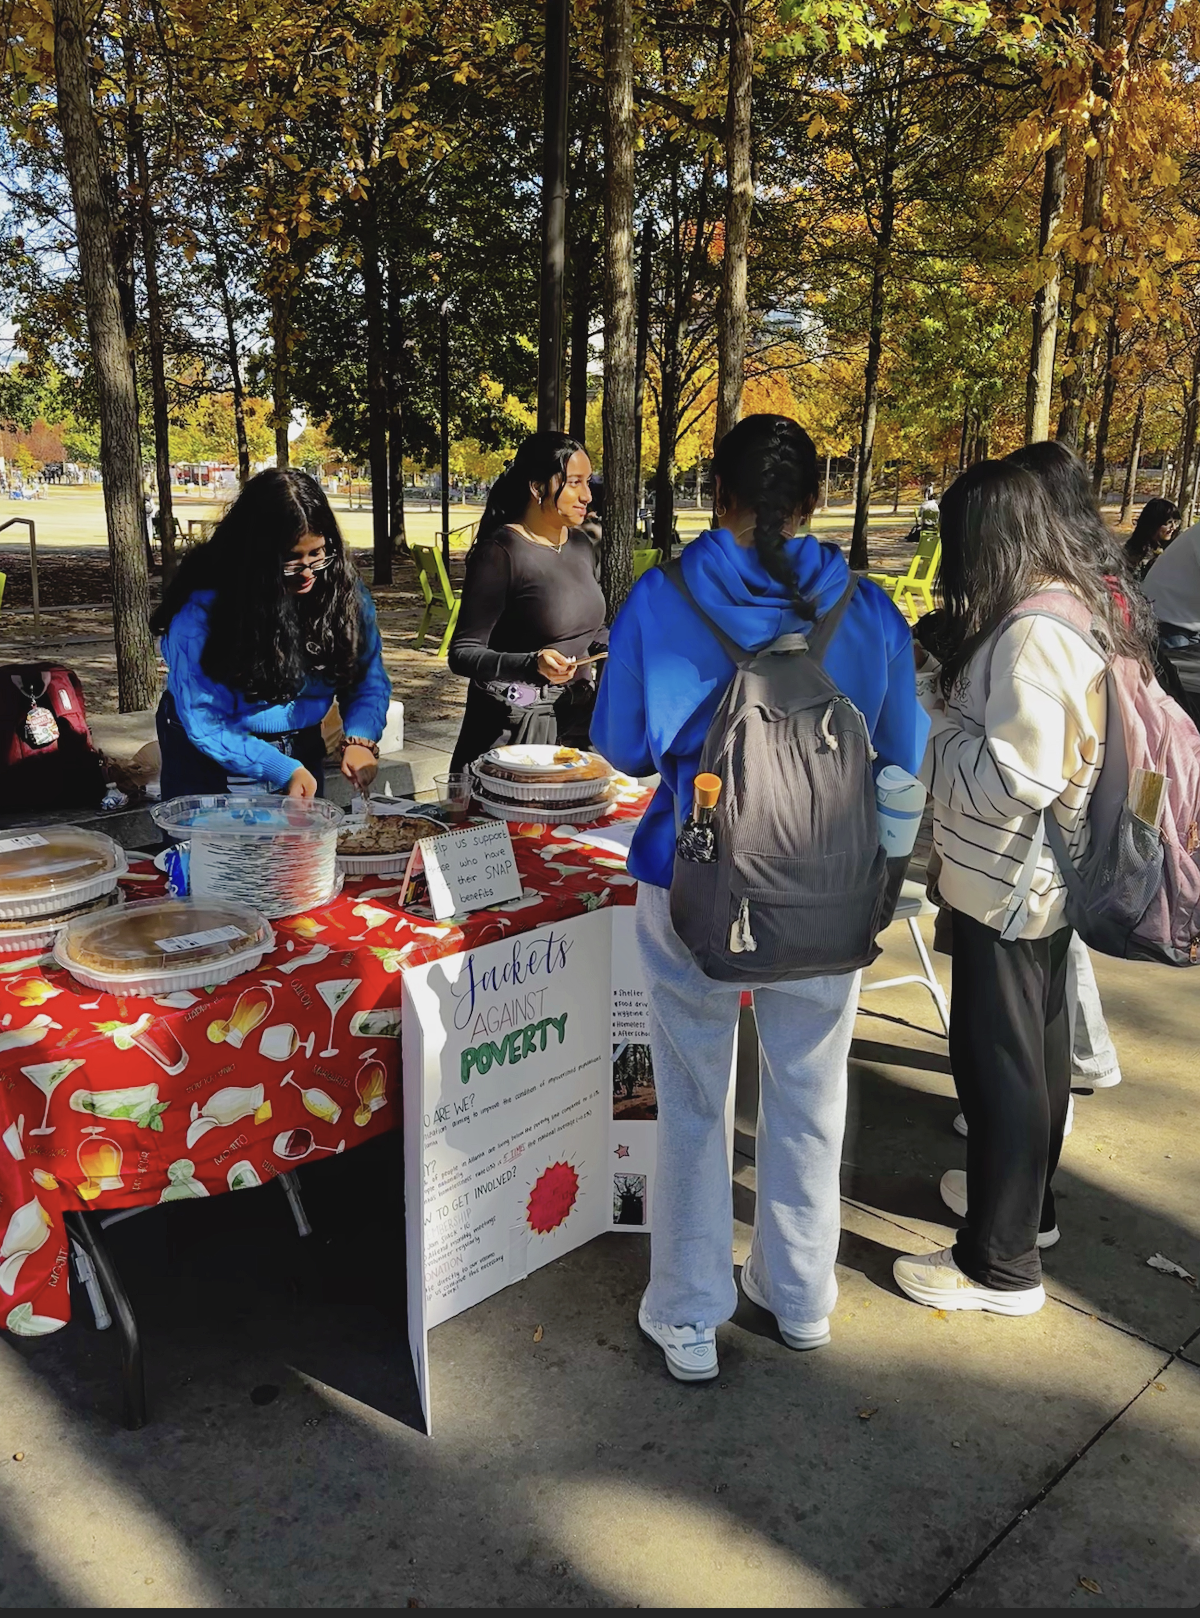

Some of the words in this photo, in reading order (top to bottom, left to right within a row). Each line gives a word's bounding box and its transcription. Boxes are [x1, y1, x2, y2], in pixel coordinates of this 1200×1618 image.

[424, 843, 448, 857] Help
[455, 839, 467, 849] us
[473, 829, 508, 847] support
[459, 857, 478, 868] who
[484, 847, 506, 860] have
[457, 874, 478, 885] their
[485, 859, 512, 880] SNAP
[459, 887, 494, 903] benefits
[450, 931, 574, 1031] Jackets
[618, 988, 643, 997] Shelter
[470, 986, 548, 1043] AGAINST
[616, 1021, 646, 1029] Homeless
[459, 1012, 568, 1085] POVERTY
[433, 1103, 450, 1125] ARE
[454, 1092, 475, 1115] WE?
[452, 1115, 470, 1128] aiming
[480, 1101, 500, 1114] improve
[502, 1097, 512, 1105] the
[514, 1085, 537, 1100] condition
[539, 1079, 545, 1088] of
[547, 1066, 577, 1084] impoverished
[432, 1174, 438, 1183] of
[441, 1165, 458, 1179] people
[467, 1151, 485, 1165] Atlanta
[487, 1146, 496, 1154] are
[497, 1139, 510, 1149] living
[511, 1131, 524, 1141] below
[524, 1126, 532, 1134] the
[533, 1117, 550, 1130] poverty
[551, 1112, 560, 1120] line
[561, 1100, 581, 1115] compared
[438, 1174, 472, 1197] homelessness
[510, 1142, 526, 1158] TIMES
[527, 1140, 536, 1149] the
[537, 1127, 556, 1143] national
[556, 1119, 575, 1133] average
[436, 1204, 449, 1220] TO
[451, 1192, 469, 1211] GET
[474, 1165, 517, 1199] INVOLVED?
[438, 1172, 463, 1189] nationally
[426, 1207, 472, 1239] EMBERSHIP
[428, 1243, 449, 1259] Attend
[450, 1232, 472, 1247] monthly
[473, 1215, 497, 1233] meetings
[441, 1230, 458, 1244] Slack
[427, 1249, 453, 1267] volunteer
[455, 1236, 481, 1252] regularly
[425, 1253, 464, 1282] ONATION
[437, 1271, 460, 1287] directly
[461, 1266, 468, 1274] to
[469, 1260, 479, 1269] our
[442, 1275, 466, 1292] continue
[469, 1268, 480, 1278] this
[480, 1254, 504, 1271] necessary
[441, 1285, 460, 1298] work!
